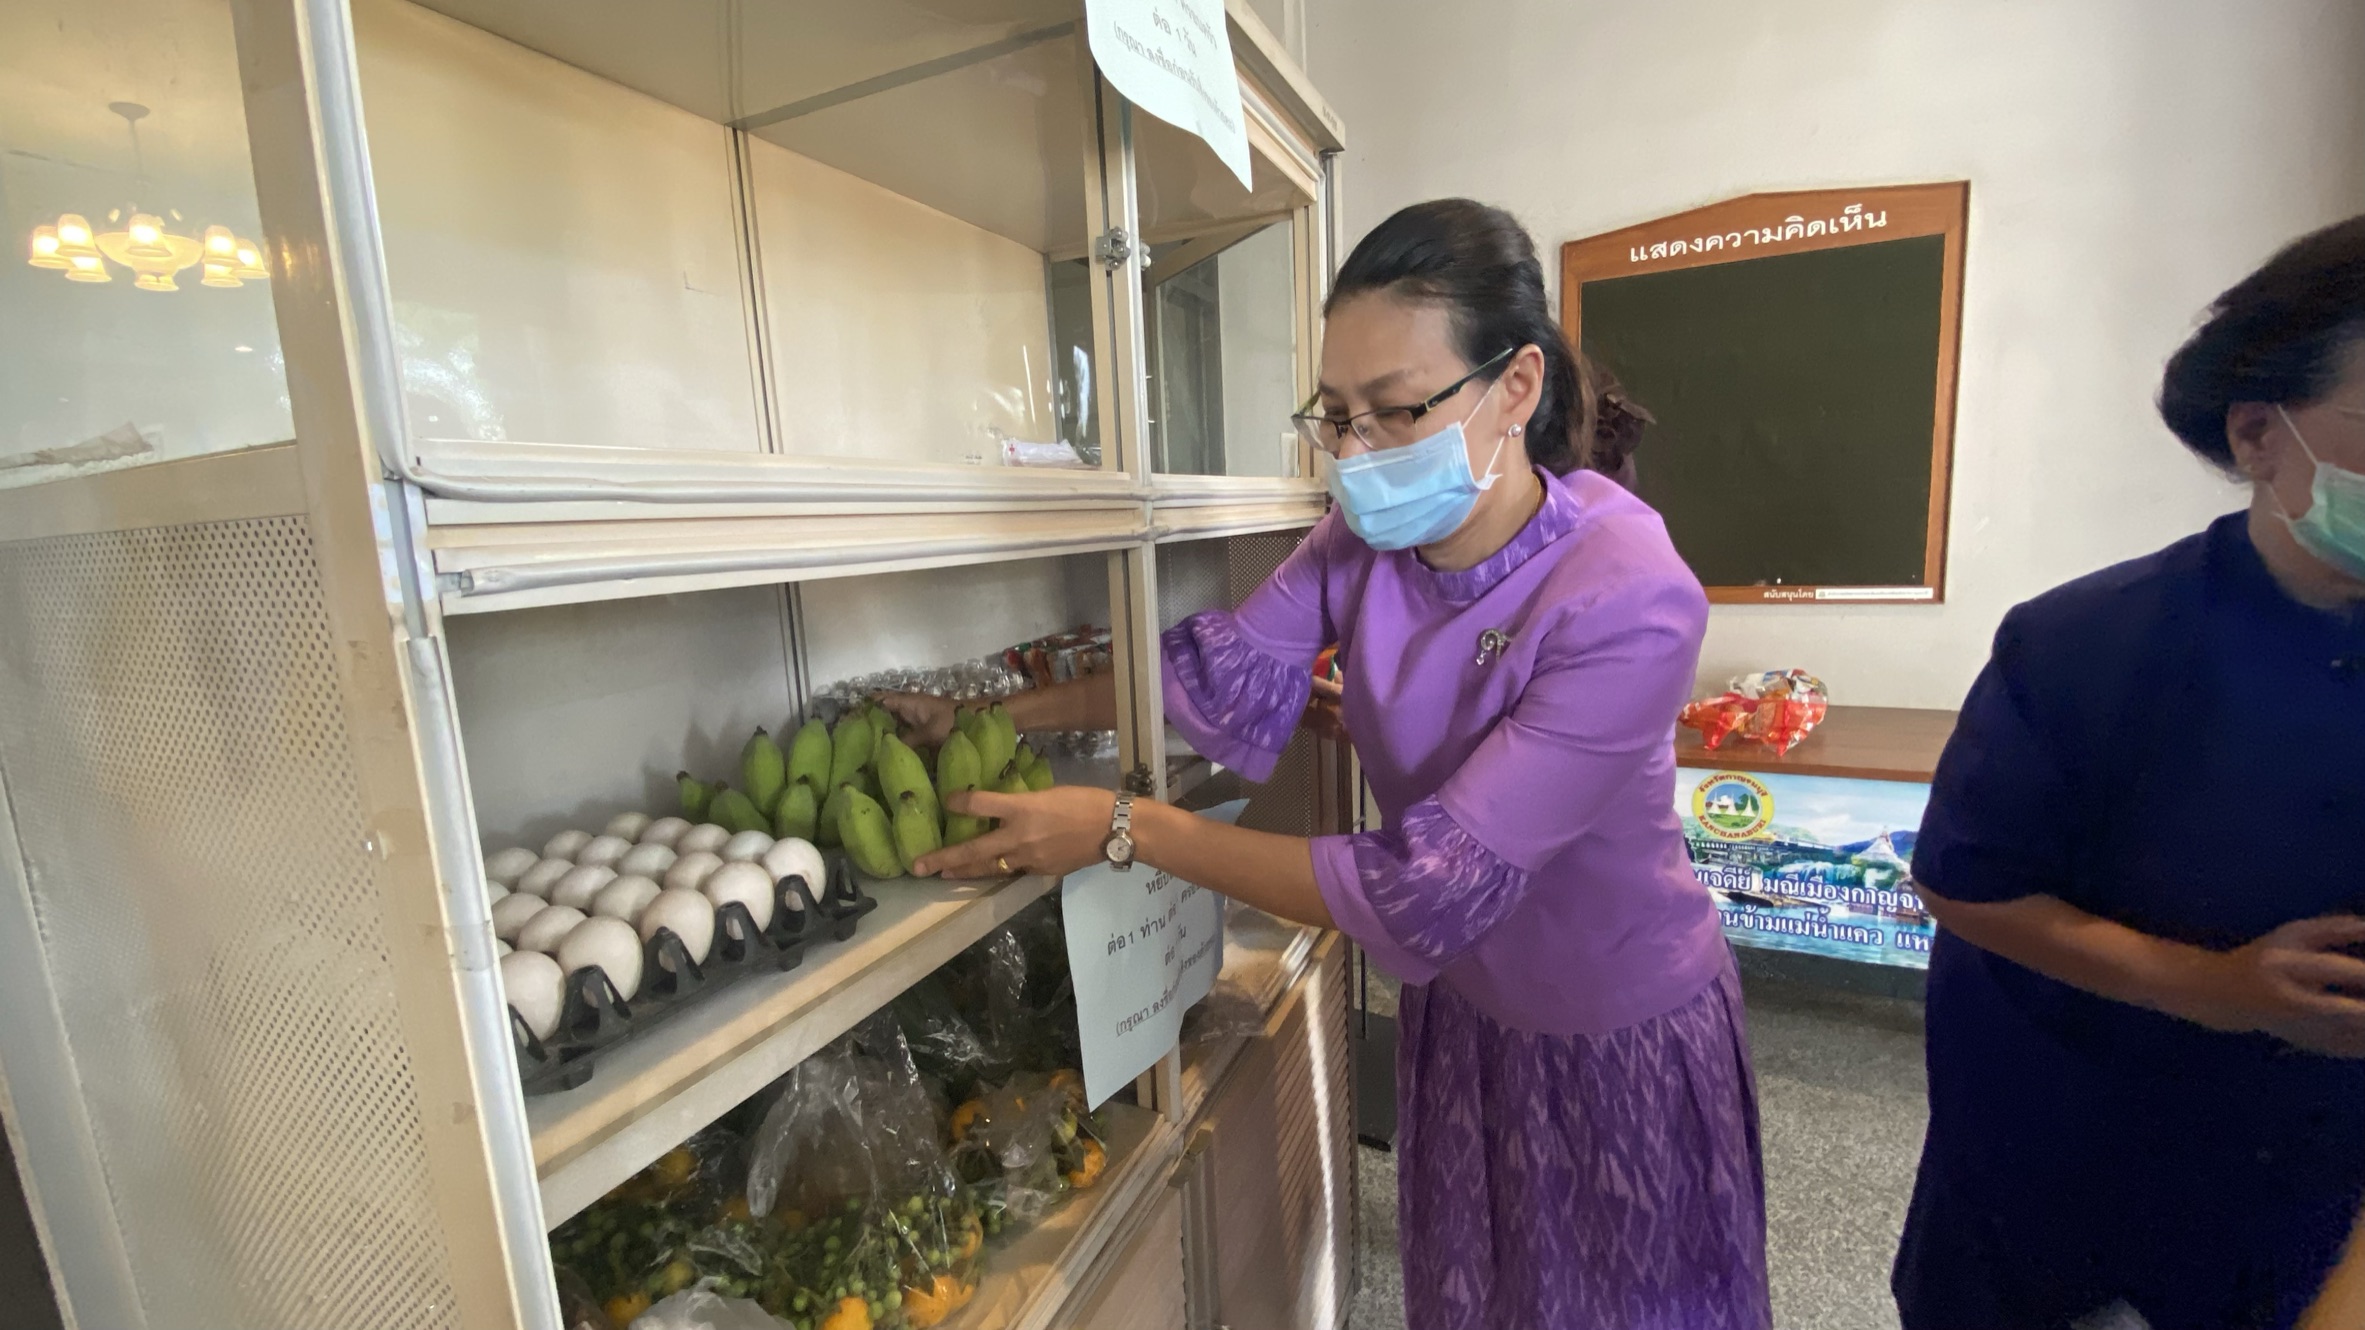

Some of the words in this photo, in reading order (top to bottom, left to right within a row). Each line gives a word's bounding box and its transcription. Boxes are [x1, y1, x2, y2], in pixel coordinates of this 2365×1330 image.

[1153, 6, 1171, 35] ต่อ
[1630, 203, 1887, 262] แสดงความคิดเห็น
[1763, 587, 1814, 602] สนับสนุนโดย
[1698, 815, 1767, 838] KANCHANABURI
[1140, 916, 1166, 939] ท่าน
